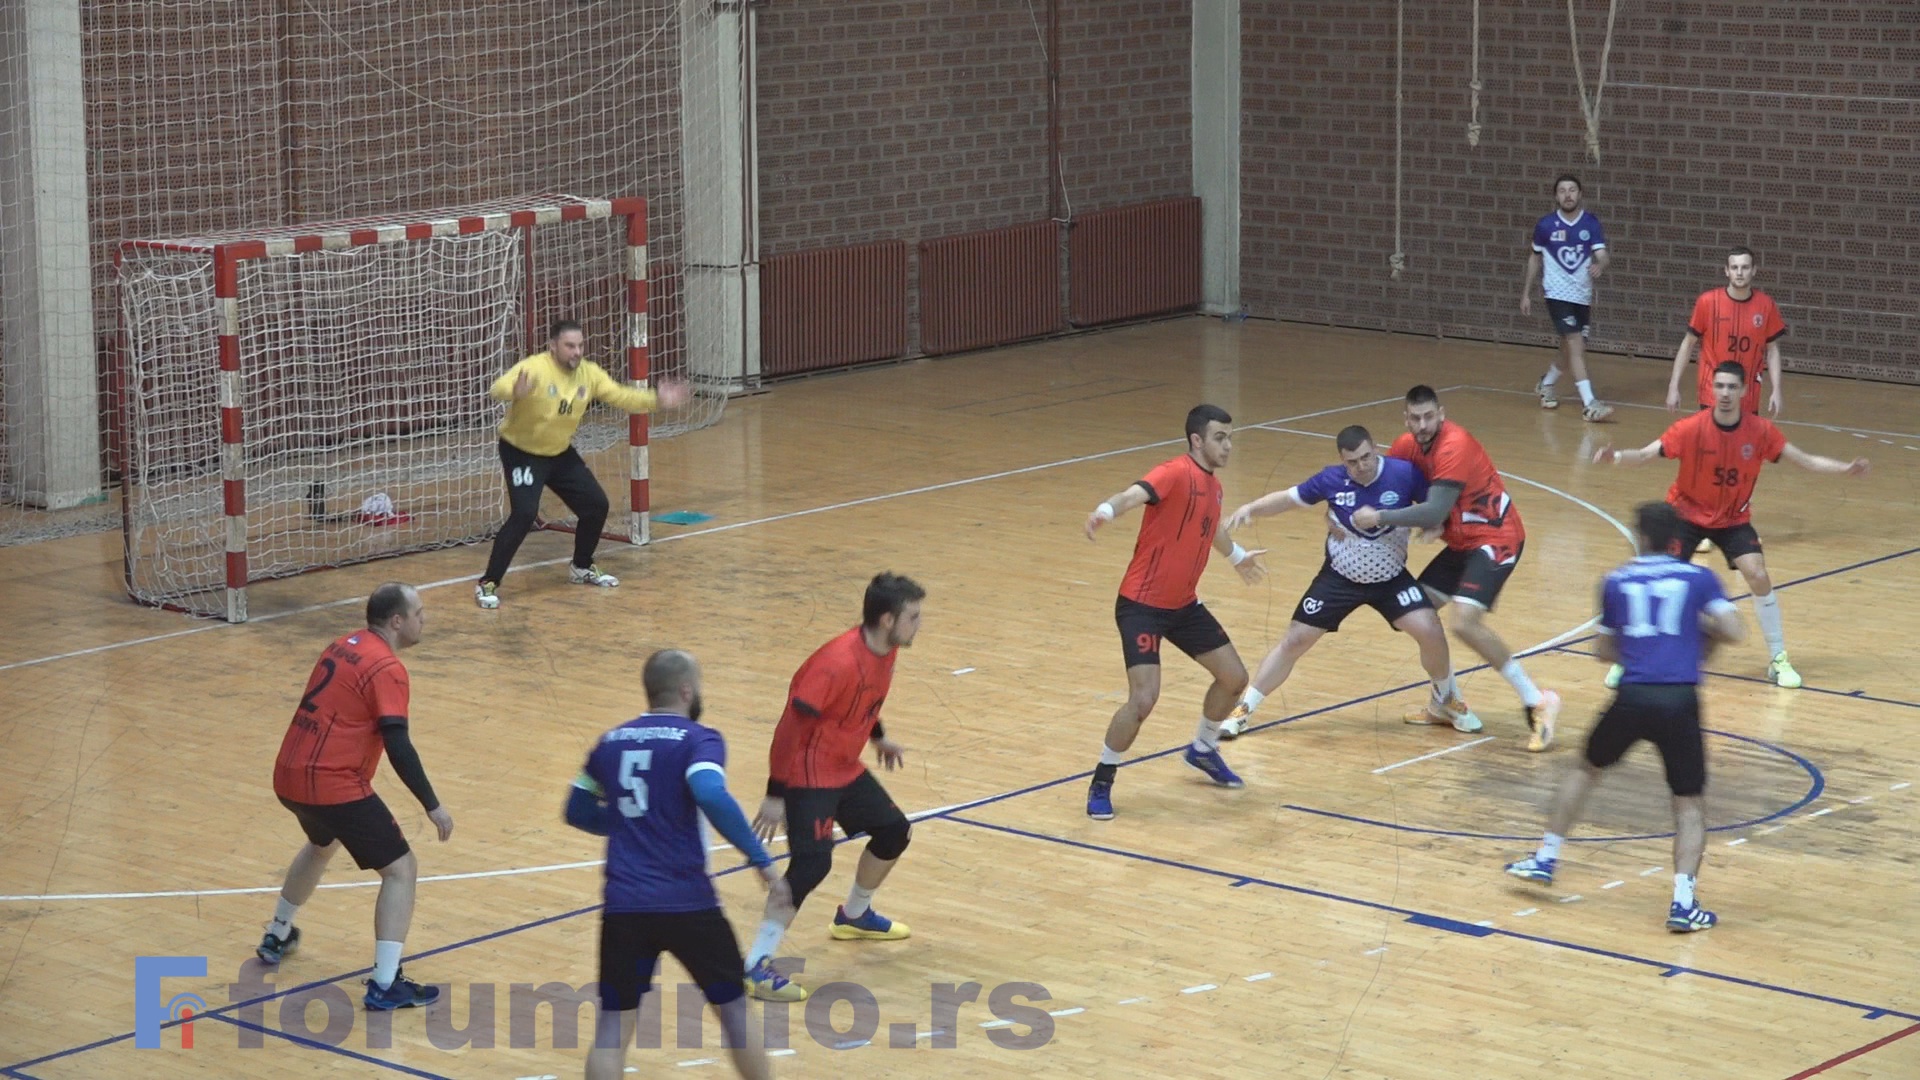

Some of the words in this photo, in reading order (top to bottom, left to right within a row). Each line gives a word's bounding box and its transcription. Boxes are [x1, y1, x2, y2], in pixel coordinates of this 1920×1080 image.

[1728, 334, 1751, 353] 20
[512, 466, 534, 487] 86
[1713, 467, 1738, 487] 58
[1200, 515, 1213, 538] 91
[1618, 578, 1690, 638] 17
[1136, 632, 1159, 653] 91
[300, 657, 336, 713] 2
[617, 749, 653, 818] 5
[814, 816, 834, 841] 14
